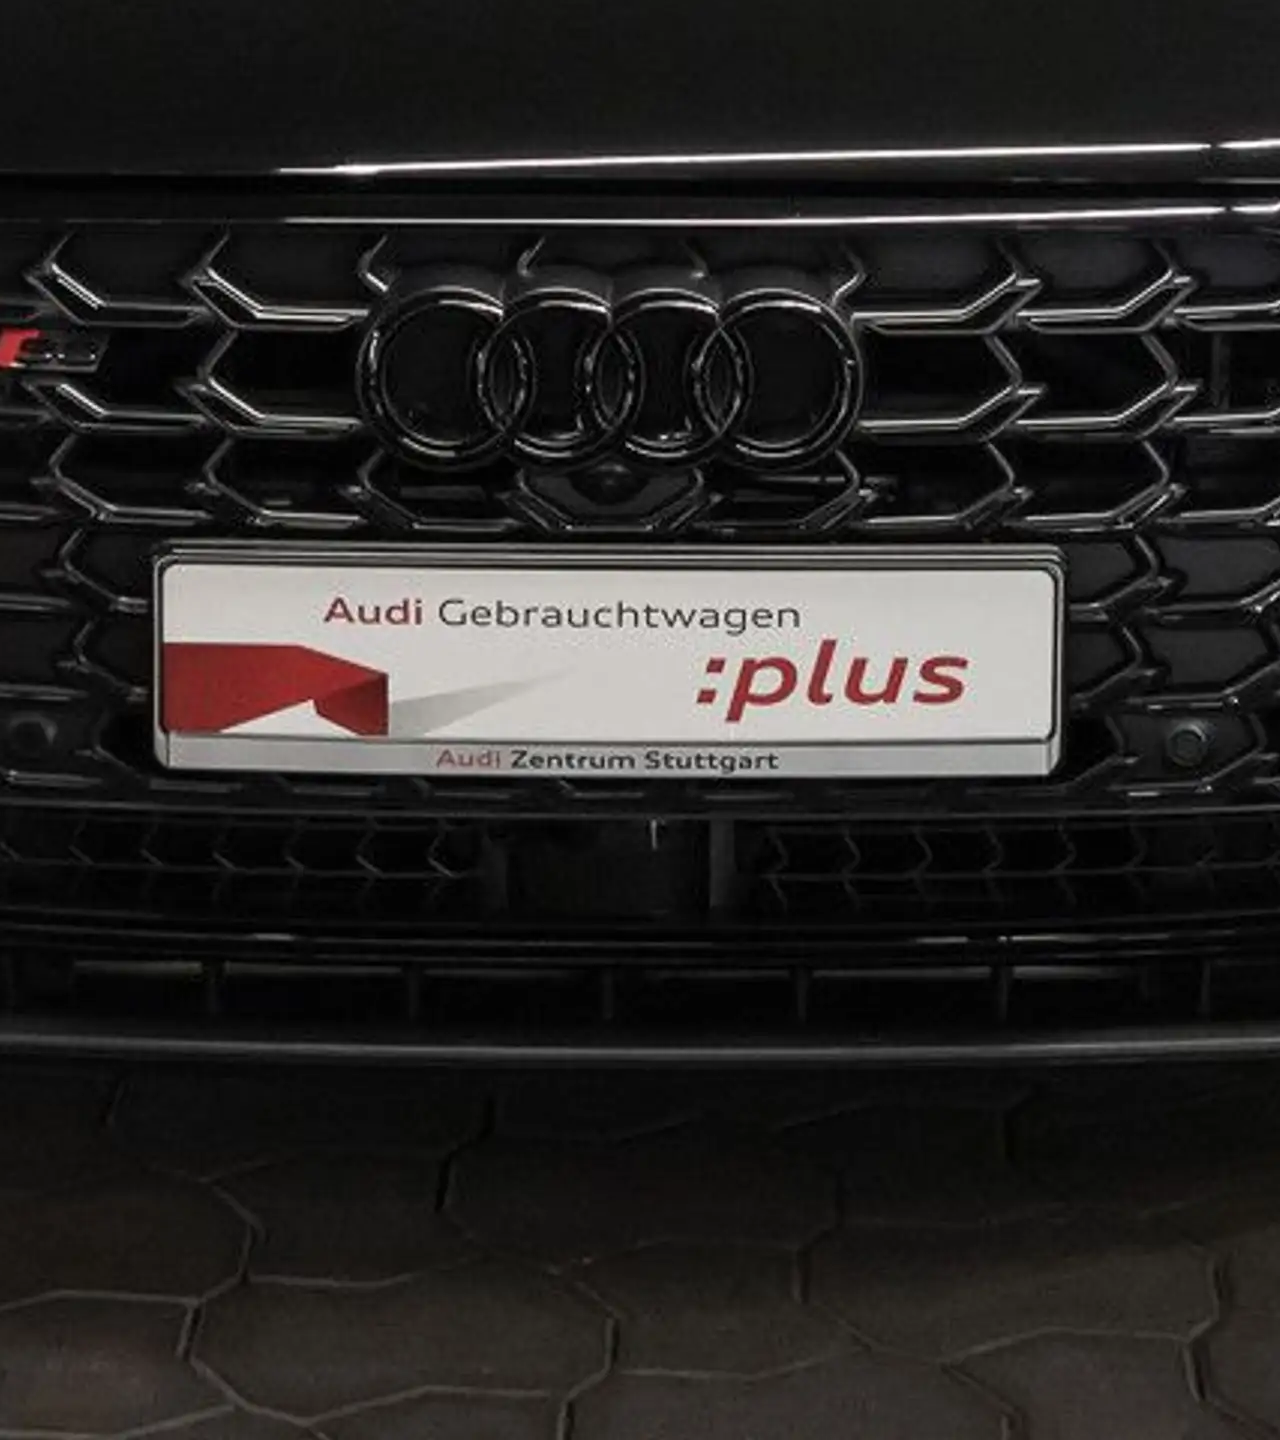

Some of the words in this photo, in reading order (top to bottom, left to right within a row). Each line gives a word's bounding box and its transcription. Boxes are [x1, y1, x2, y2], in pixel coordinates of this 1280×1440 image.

[322, 596, 423, 626] Audi
[438, 597, 801, 637] Gebrauchtwagen
[695, 638, 970, 724] :plus
[436, 748, 501, 769] Audi
[510, 749, 636, 769] Zentrum
[644, 749, 780, 774] Stuttgart
